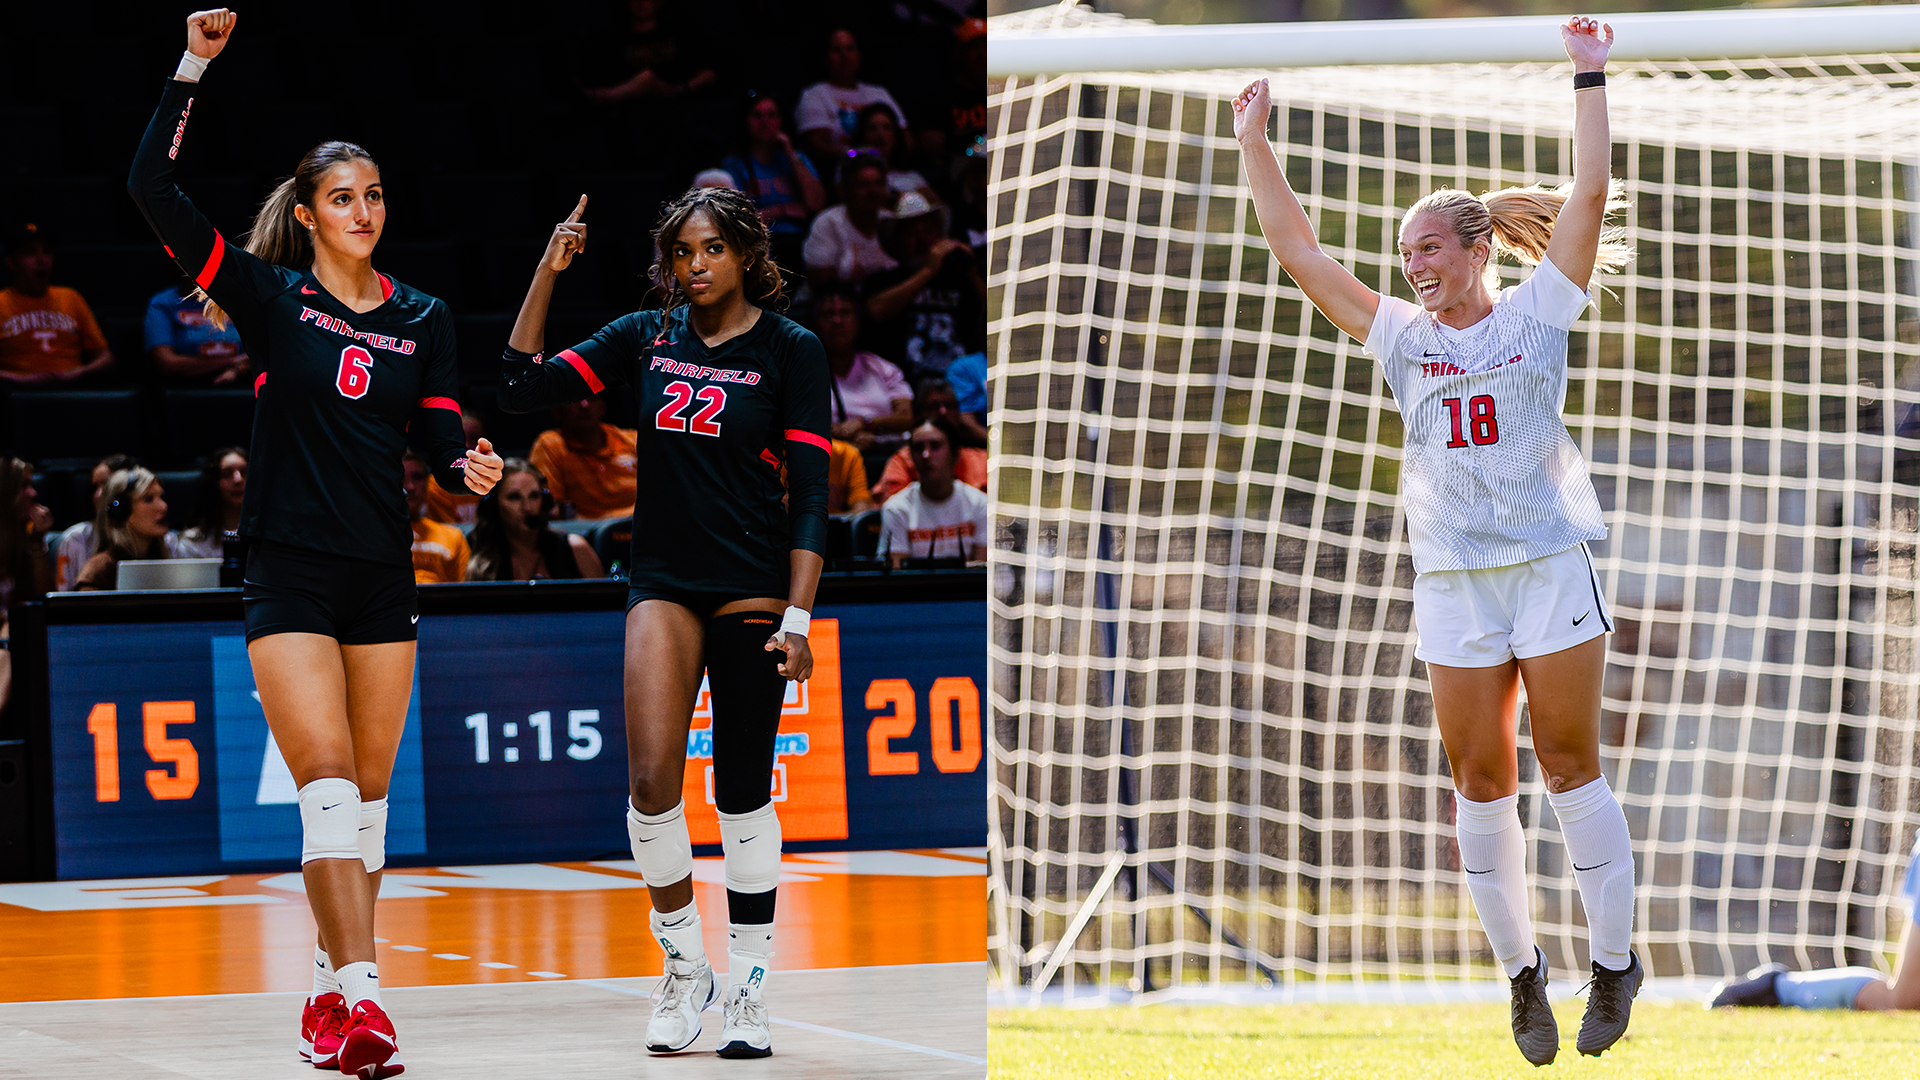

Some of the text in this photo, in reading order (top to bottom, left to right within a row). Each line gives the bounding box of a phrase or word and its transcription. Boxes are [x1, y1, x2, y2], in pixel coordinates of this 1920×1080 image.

[300, 306, 416, 355] FAIRFIELD
[336, 345, 374, 400] 6
[649, 356, 761, 385] FAIRFIELD
[1421, 354, 1522, 378] FAIRD
[655, 381, 727, 437] 22
[1442, 394, 1499, 449] 18
[88, 700, 199, 802] 15
[465, 709, 603, 763] 1:15
[865, 676, 982, 775] 20
